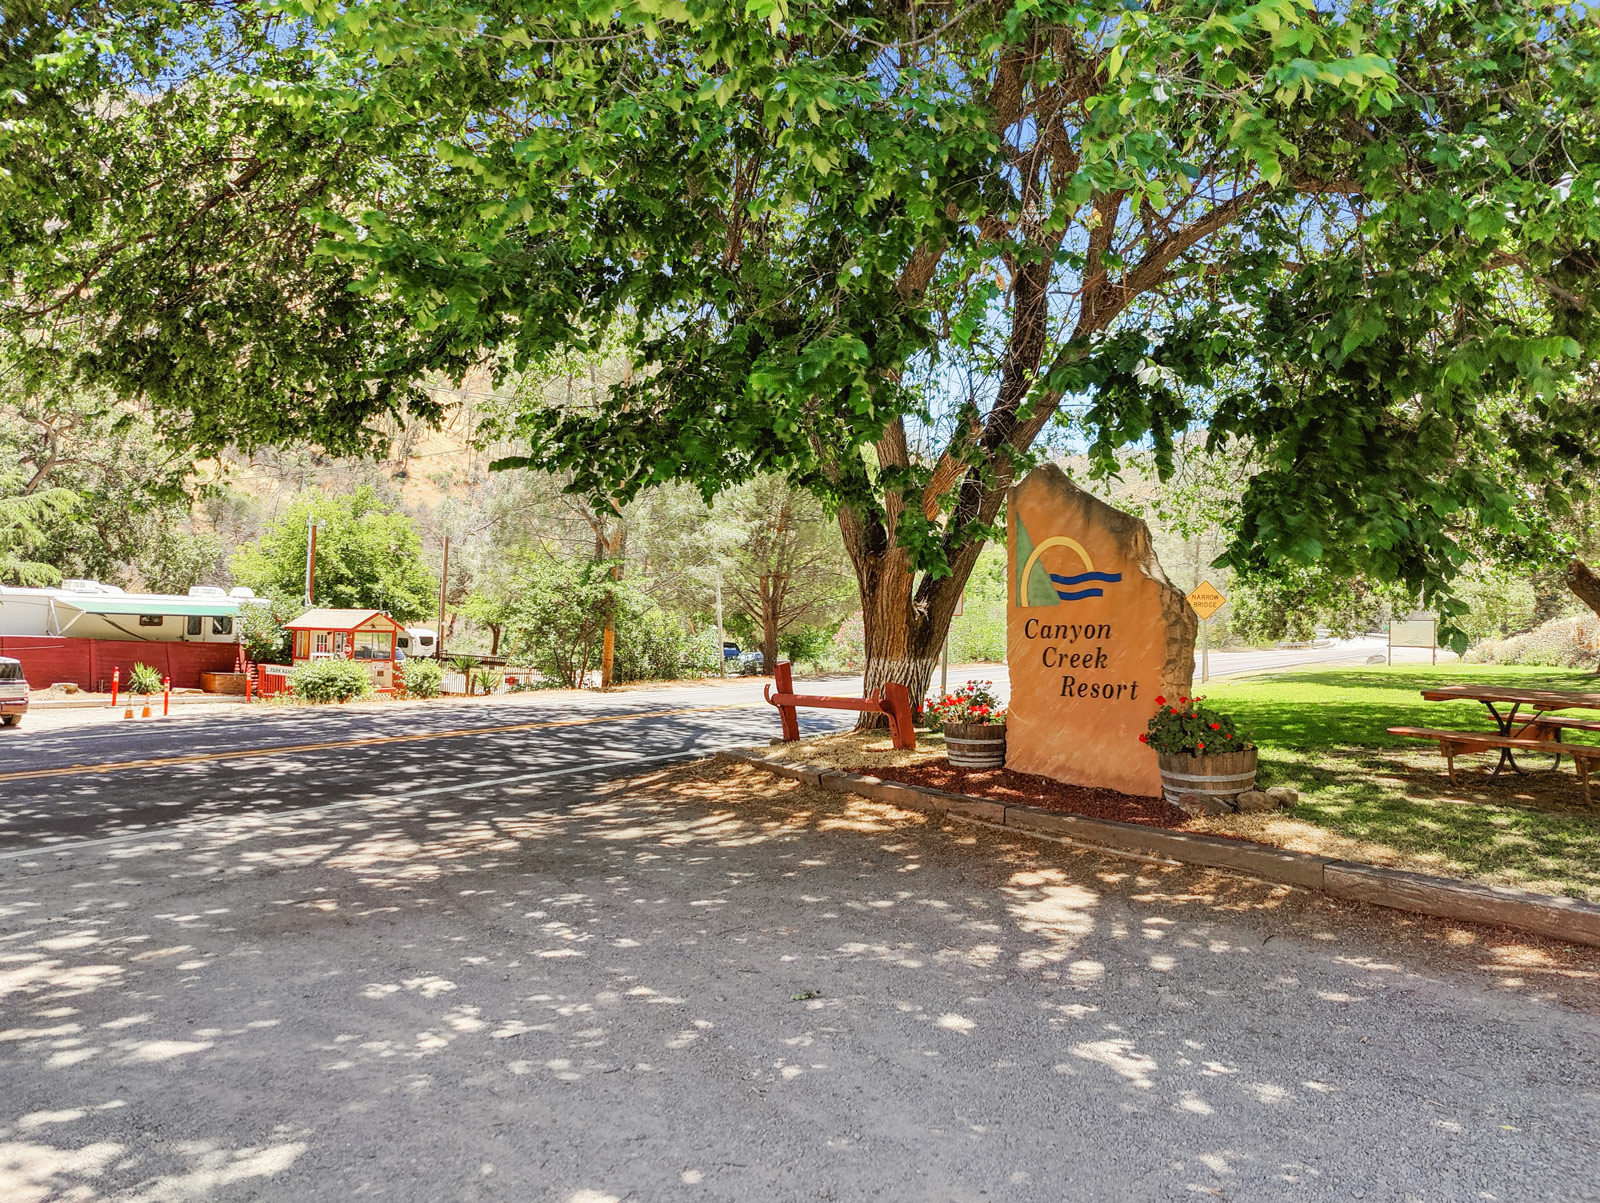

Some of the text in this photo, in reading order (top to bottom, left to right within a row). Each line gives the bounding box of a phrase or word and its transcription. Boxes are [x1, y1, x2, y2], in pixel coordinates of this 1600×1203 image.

[1024, 618, 1112, 644] Canyon
[1042, 646, 1108, 669] Creek
[1060, 675, 1139, 701] Resort
